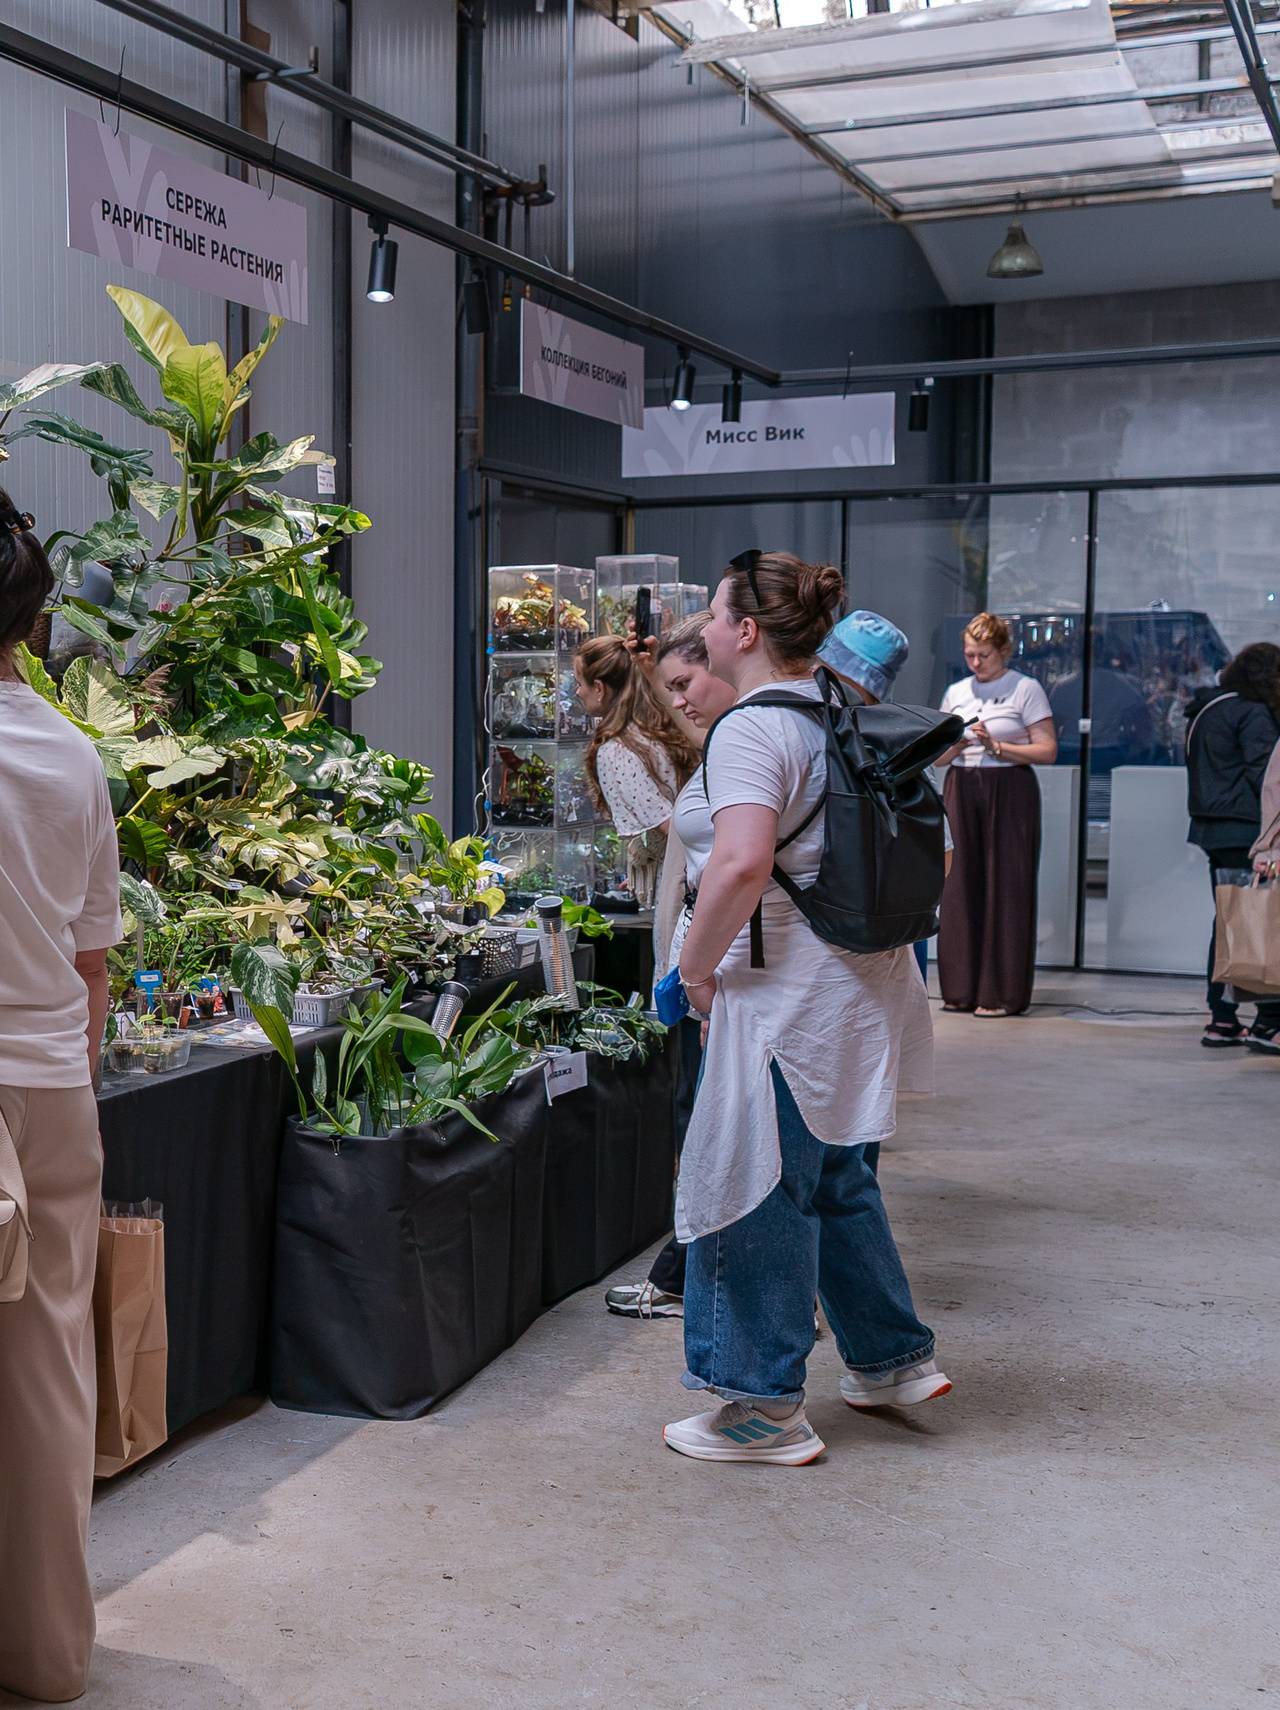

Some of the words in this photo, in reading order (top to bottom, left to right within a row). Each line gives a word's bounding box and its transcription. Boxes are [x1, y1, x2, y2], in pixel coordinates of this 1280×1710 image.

[165, 187, 228, 229] СЕРЕЖА
[101, 198, 206, 257] РАРИТЕТНЫЕ
[211, 239, 284, 284] РАСТЕНИЯ
[540, 346, 590, 377] КОЛЛЕКЦИЯ
[591, 365, 628, 390] БЕГОНИЙ
[706, 429, 758, 445] Мисс
[765, 426, 805, 441] Вик
